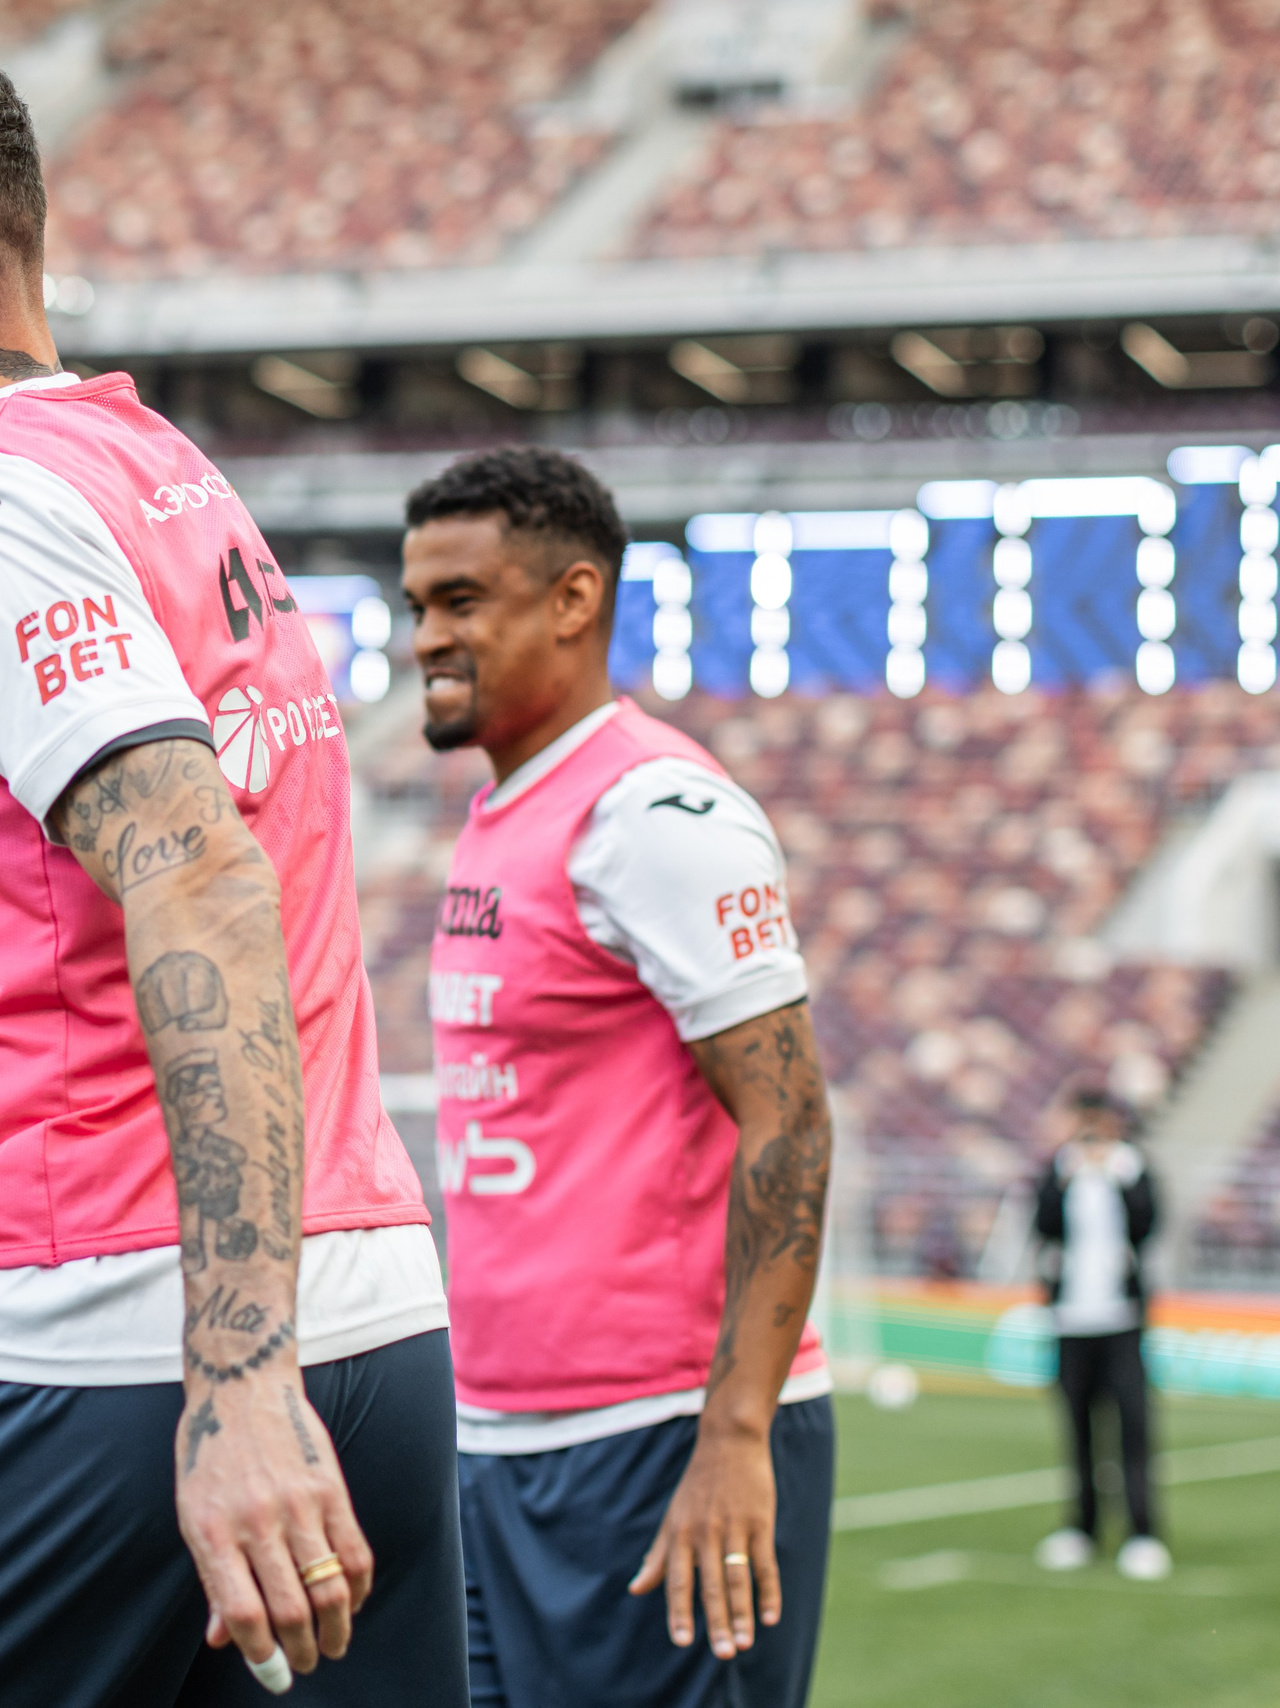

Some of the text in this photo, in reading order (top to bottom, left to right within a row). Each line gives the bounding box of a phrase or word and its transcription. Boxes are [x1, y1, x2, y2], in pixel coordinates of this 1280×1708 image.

[15, 595, 119, 663] FON
[34, 633, 132, 706] BET
[715, 883, 779, 926] FON
[731, 916, 787, 960] BET
